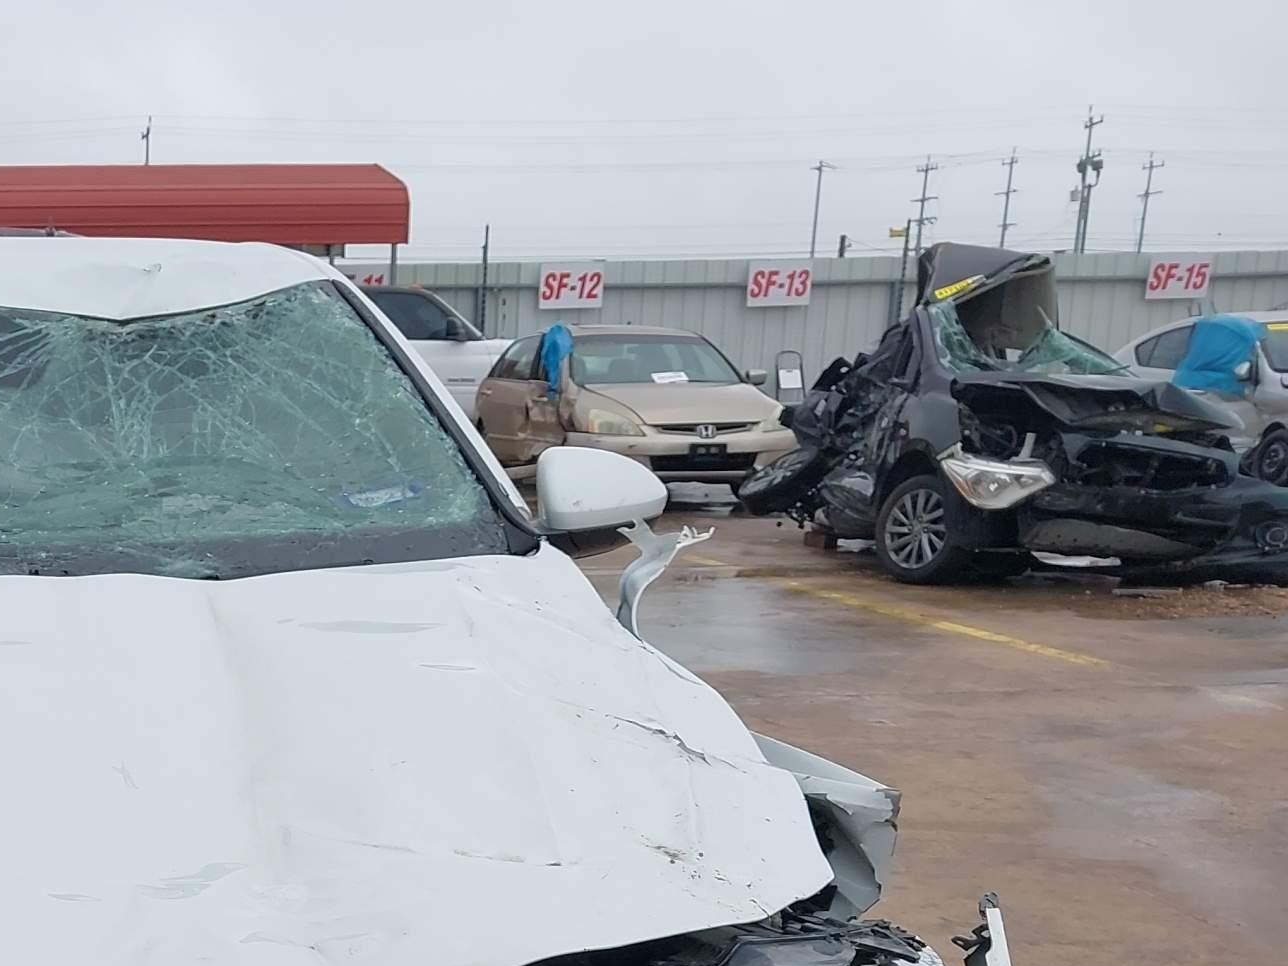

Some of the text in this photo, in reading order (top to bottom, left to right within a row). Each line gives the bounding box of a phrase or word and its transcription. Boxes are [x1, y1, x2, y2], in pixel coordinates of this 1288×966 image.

[541, 271, 603, 301] SF-12
[750, 269, 810, 299] SF-13
[1148, 262, 1210, 291] SF-15
